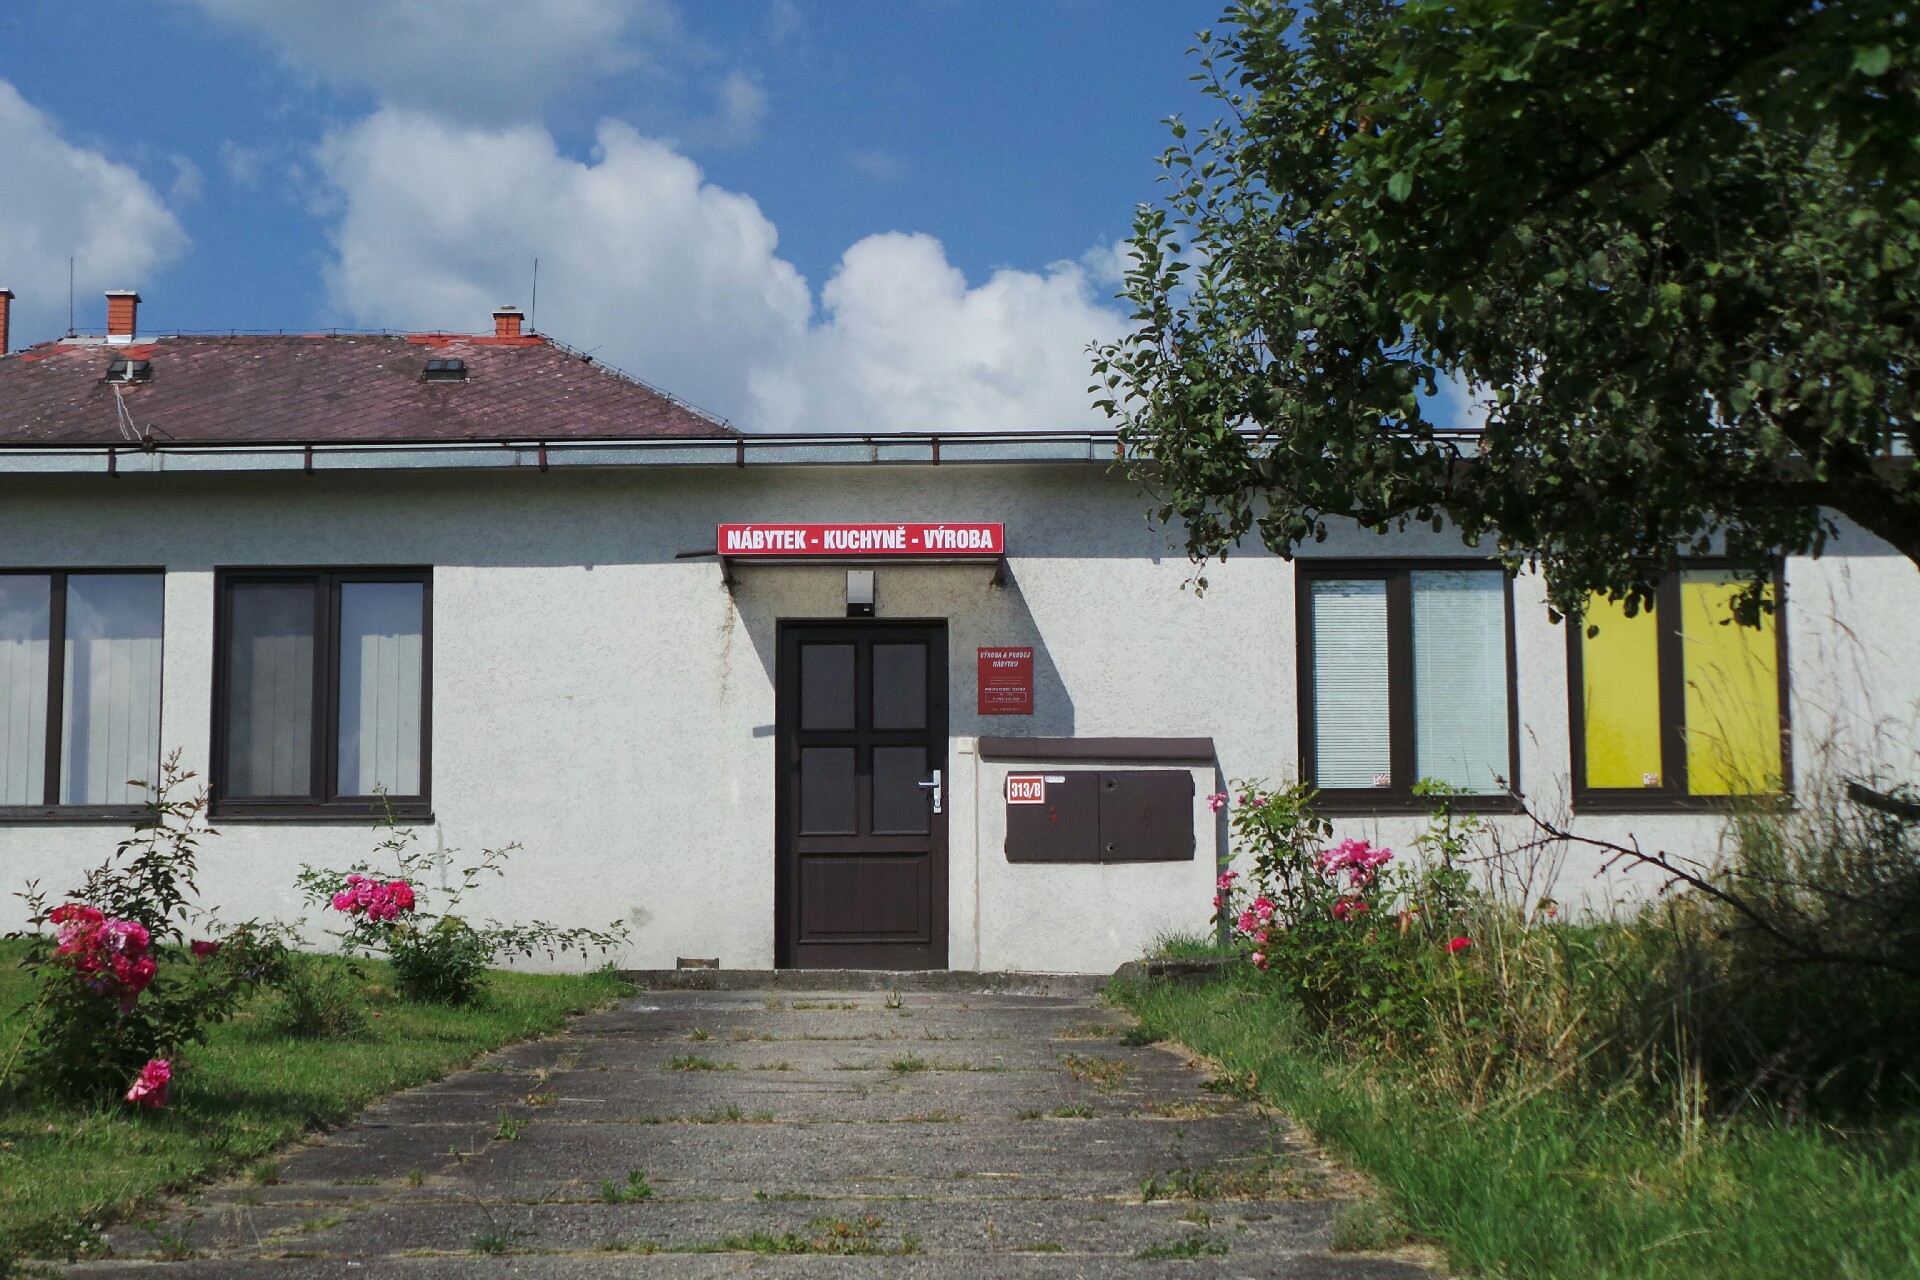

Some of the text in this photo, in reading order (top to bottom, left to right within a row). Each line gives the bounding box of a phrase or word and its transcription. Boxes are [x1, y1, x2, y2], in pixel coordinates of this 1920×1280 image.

[727, 526, 807, 550] NÁBYTEK
[823, 526, 906, 549] KUCHYNĚ
[923, 525, 993, 549] VÝROBA
[980, 650, 1002, 659] VÝROBA
[1008, 651, 1031, 659] PRODEJ
[992, 659, 1019, 668] NÁBYTKU
[1011, 782, 1041, 798] 313/B
